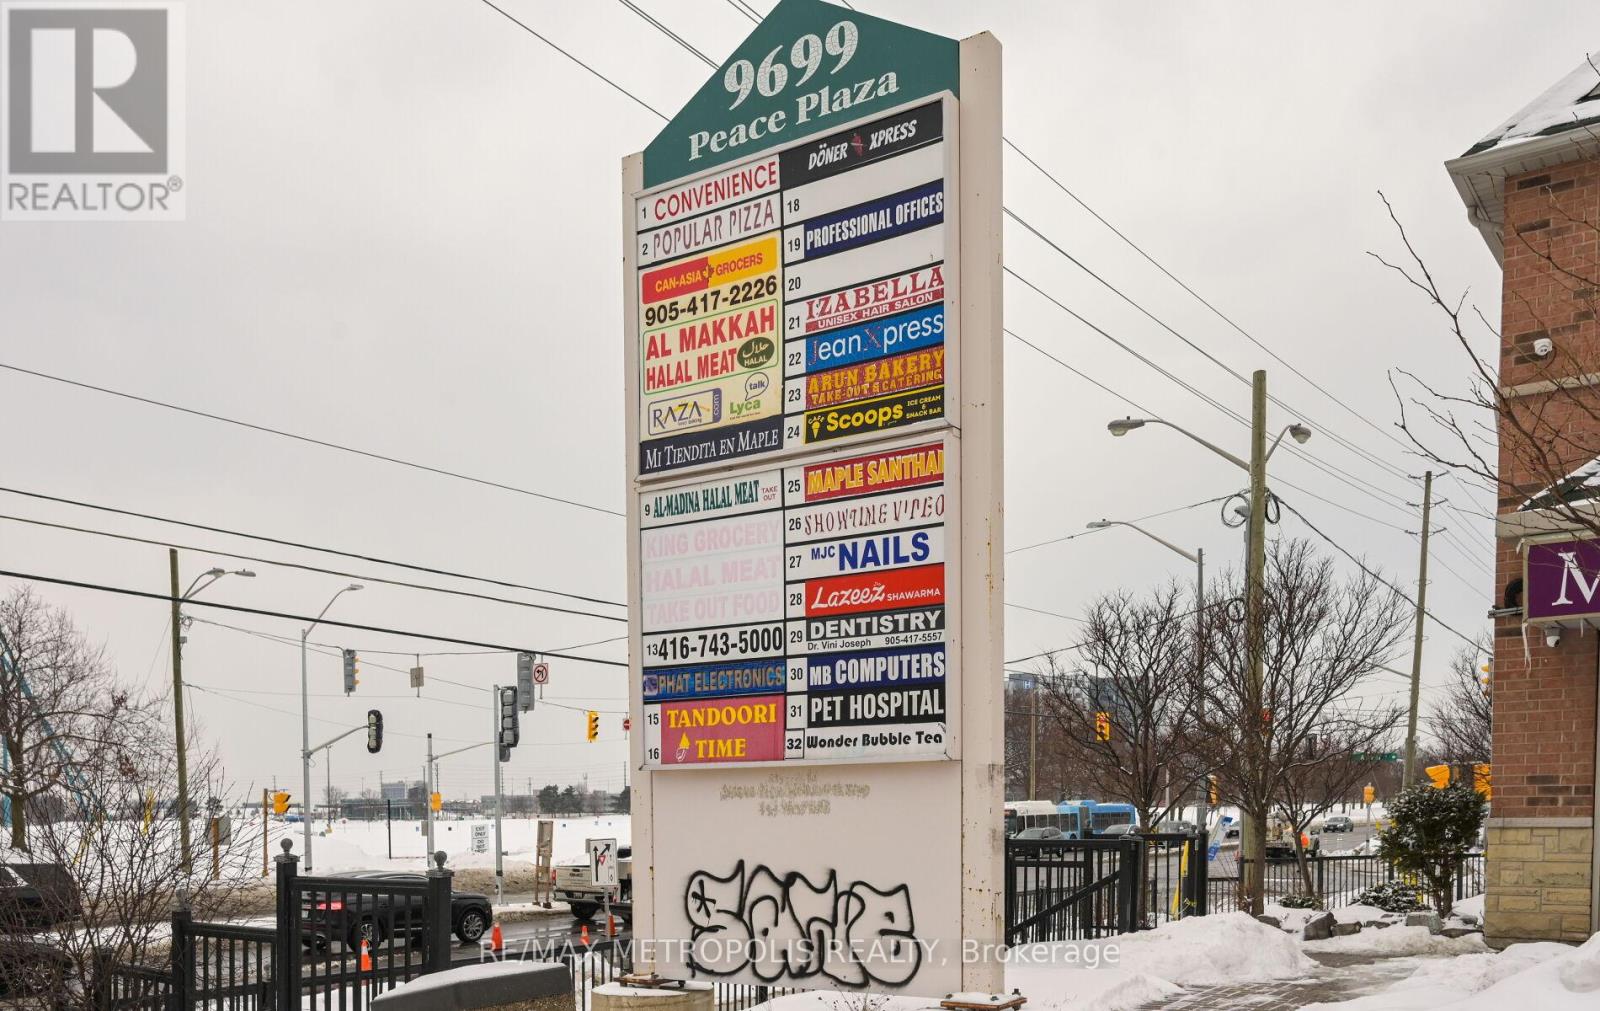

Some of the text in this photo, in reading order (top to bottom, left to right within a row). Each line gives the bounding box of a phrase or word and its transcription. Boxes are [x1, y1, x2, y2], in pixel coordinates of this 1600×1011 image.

[724, 20, 858, 111] 9699
[689, 71, 899, 161] Peace Plaza
[808, 119, 917, 170] DÖNER XPRESS
[655, 161, 777, 220] CONVENIENCE
[642, 207, 647, 219] 1
[787, 198, 800, 213] 18
[653, 199, 775, 258] POPULAR PIZZA
[806, 191, 944, 250] PROFESSIONAL OFFICES
[642, 243, 648, 255] 2
[788, 238, 801, 252] 19
[655, 252, 763, 293] CAN-ASIA GROCERS
[788, 276, 801, 291] 20
[806, 266, 944, 320] IZABELLA
[645, 275, 777, 326] 905-417-2226
[818, 292, 933, 329] UNISEX HAIR SALON
[646, 305, 775, 361] AL MAKKAH
[789, 316, 800, 330] 21
[646, 347, 737, 391] HALAL MEAT
[744, 355, 767, 367] HALAL
[789, 352, 802, 366] 22
[808, 350, 944, 394] ARUN BAKERY
[749, 380, 765, 390] talk
[788, 388, 801, 402] 23
[811, 383, 869, 405] TAKE-OUT
[882, 369, 942, 390] CATERING
[653, 400, 702, 429] RAZA
[729, 399, 761, 416] Lyca
[826, 404, 904, 432] Scoops
[928, 407, 942, 415] BAR
[787, 426, 800, 439] 24
[761, 485, 778, 494] TAKE
[788, 480, 801, 493] 25
[807, 463, 864, 495] MAPLE
[653, 480, 760, 518] AL-MADINA HALAL MEAT
[644, 504, 650, 516] 9
[804, 503, 887, 536] SHOWTIME
[789, 518, 801, 531] 26
[646, 519, 780, 559] KING GROCERY
[789, 555, 802, 568] 27
[811, 532, 930, 571] MJC NAILS
[647, 555, 781, 593] HALAL MEAT
[790, 593, 802, 606] 28
[887, 587, 941, 602] SHAWARMA
[647, 591, 780, 625] TAKE OUT FOOD
[810, 610, 941, 640] DENTISTRY
[658, 626, 783, 661] 416-743-5000
[790, 630, 803, 643] 29
[807, 632, 942, 650] Dr. Vini Joseph 905-417-5557
[647, 643, 658, 656] 13
[790, 668, 803, 680] 30
[809, 651, 945, 686] MB COMPUTERS
[658, 665, 783, 694] PHAT ELECTRONICS
[667, 703, 777, 728] TANDOORI
[790, 705, 802, 717] 31
[811, 688, 944, 722] PET HOSPITAL
[648, 713, 659, 725] 15
[695, 738, 747, 759] TIME
[787, 738, 802, 750] 32
[807, 731, 943, 749] Wonder Bubble Tea
[648, 748, 659, 760] 16
